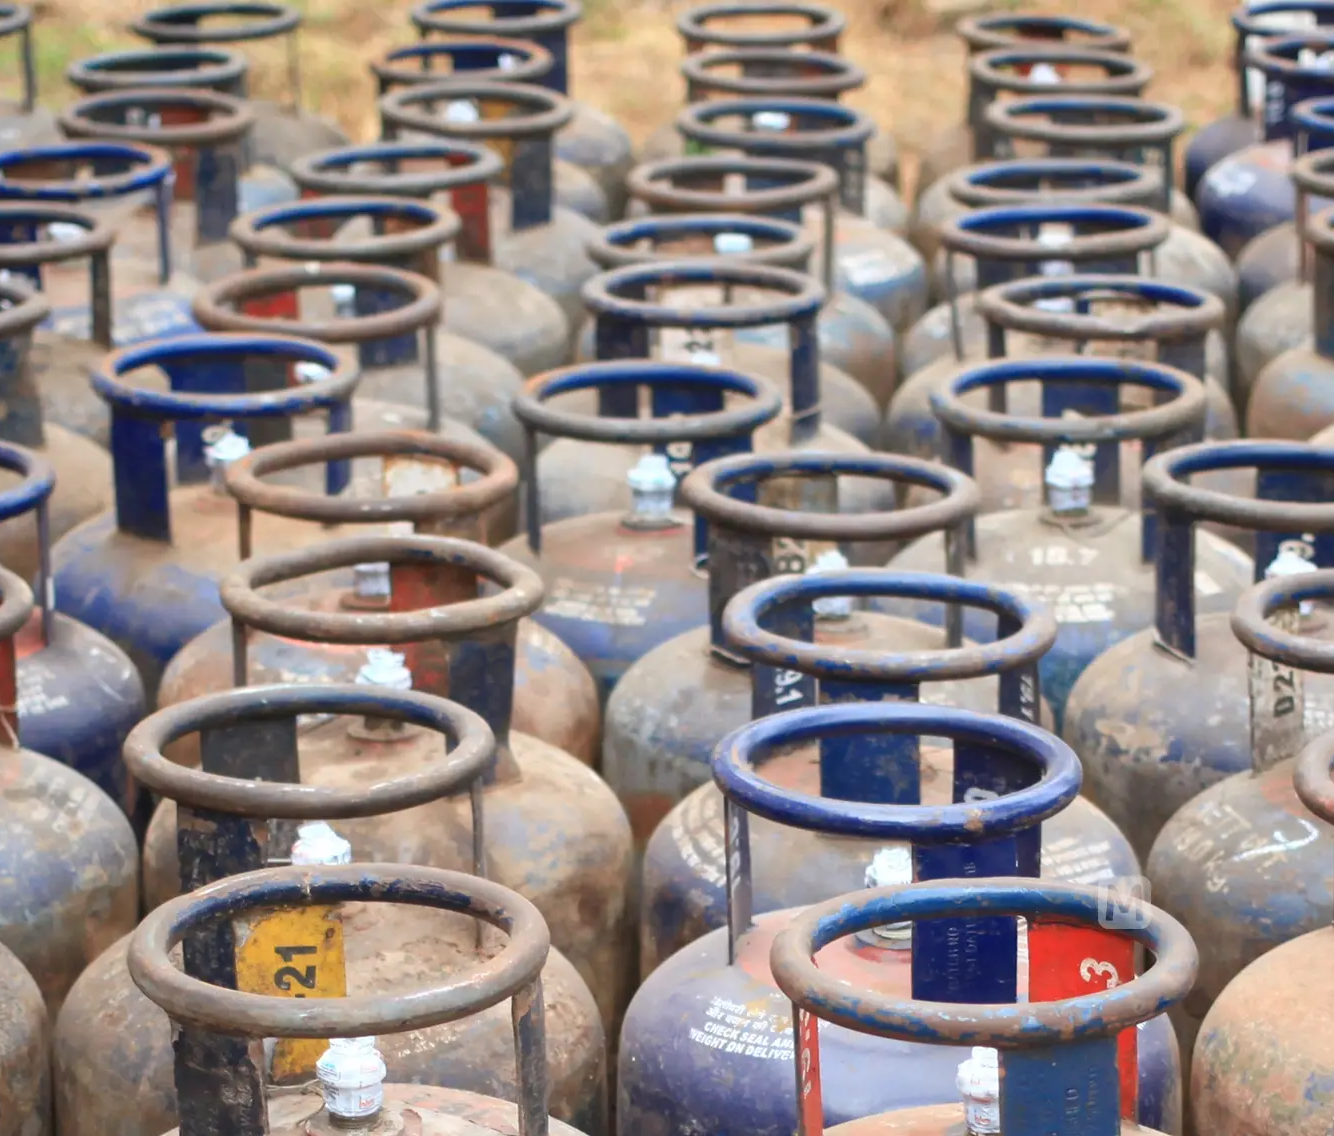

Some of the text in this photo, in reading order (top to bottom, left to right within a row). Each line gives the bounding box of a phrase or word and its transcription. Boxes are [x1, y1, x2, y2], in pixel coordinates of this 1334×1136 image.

[703, 1021, 741, 1041] CHECK
[739, 1032, 770, 1046] SEAL
[725, 1039, 744, 1054] ON
